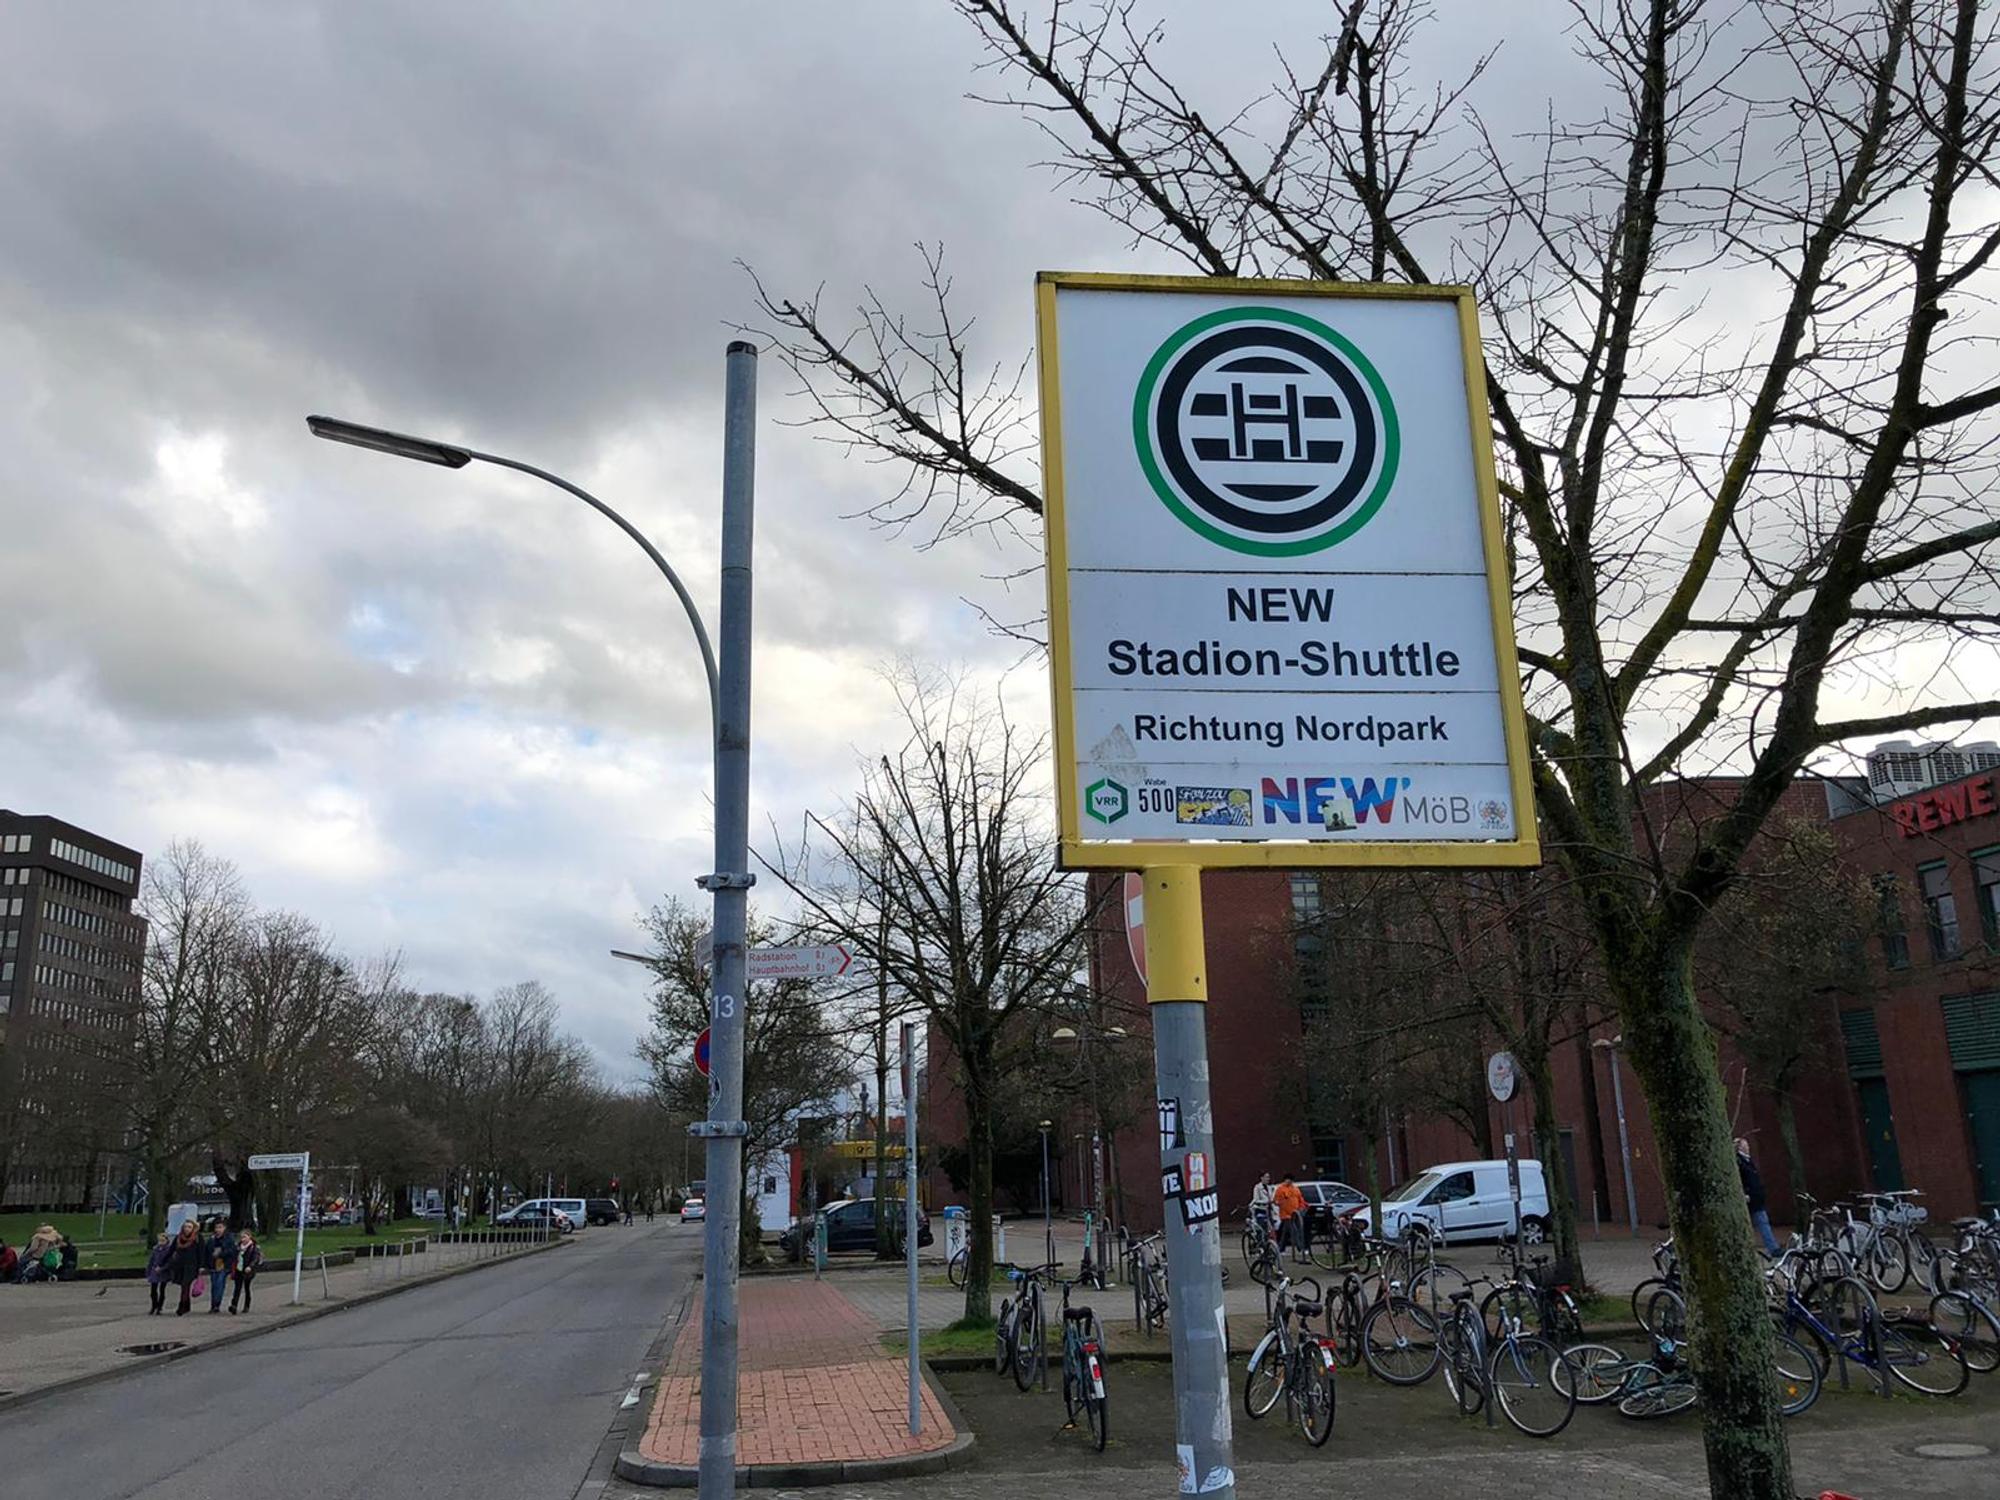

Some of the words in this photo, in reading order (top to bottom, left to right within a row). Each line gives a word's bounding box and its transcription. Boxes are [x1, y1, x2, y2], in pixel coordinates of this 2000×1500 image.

[1227, 588, 1334, 623] NEW
[1107, 639, 1460, 677] Stadion-Shuttle
[1134, 715, 1284, 748] Richtung
[1296, 715, 1448, 748] Nordpark
[1094, 796, 1120, 807] VRR
[1138, 788, 1174, 812] 500
[1403, 796, 1471, 824] MöB
[1894, 775, 1993, 838] REWE
[713, 994, 735, 1019] 13
